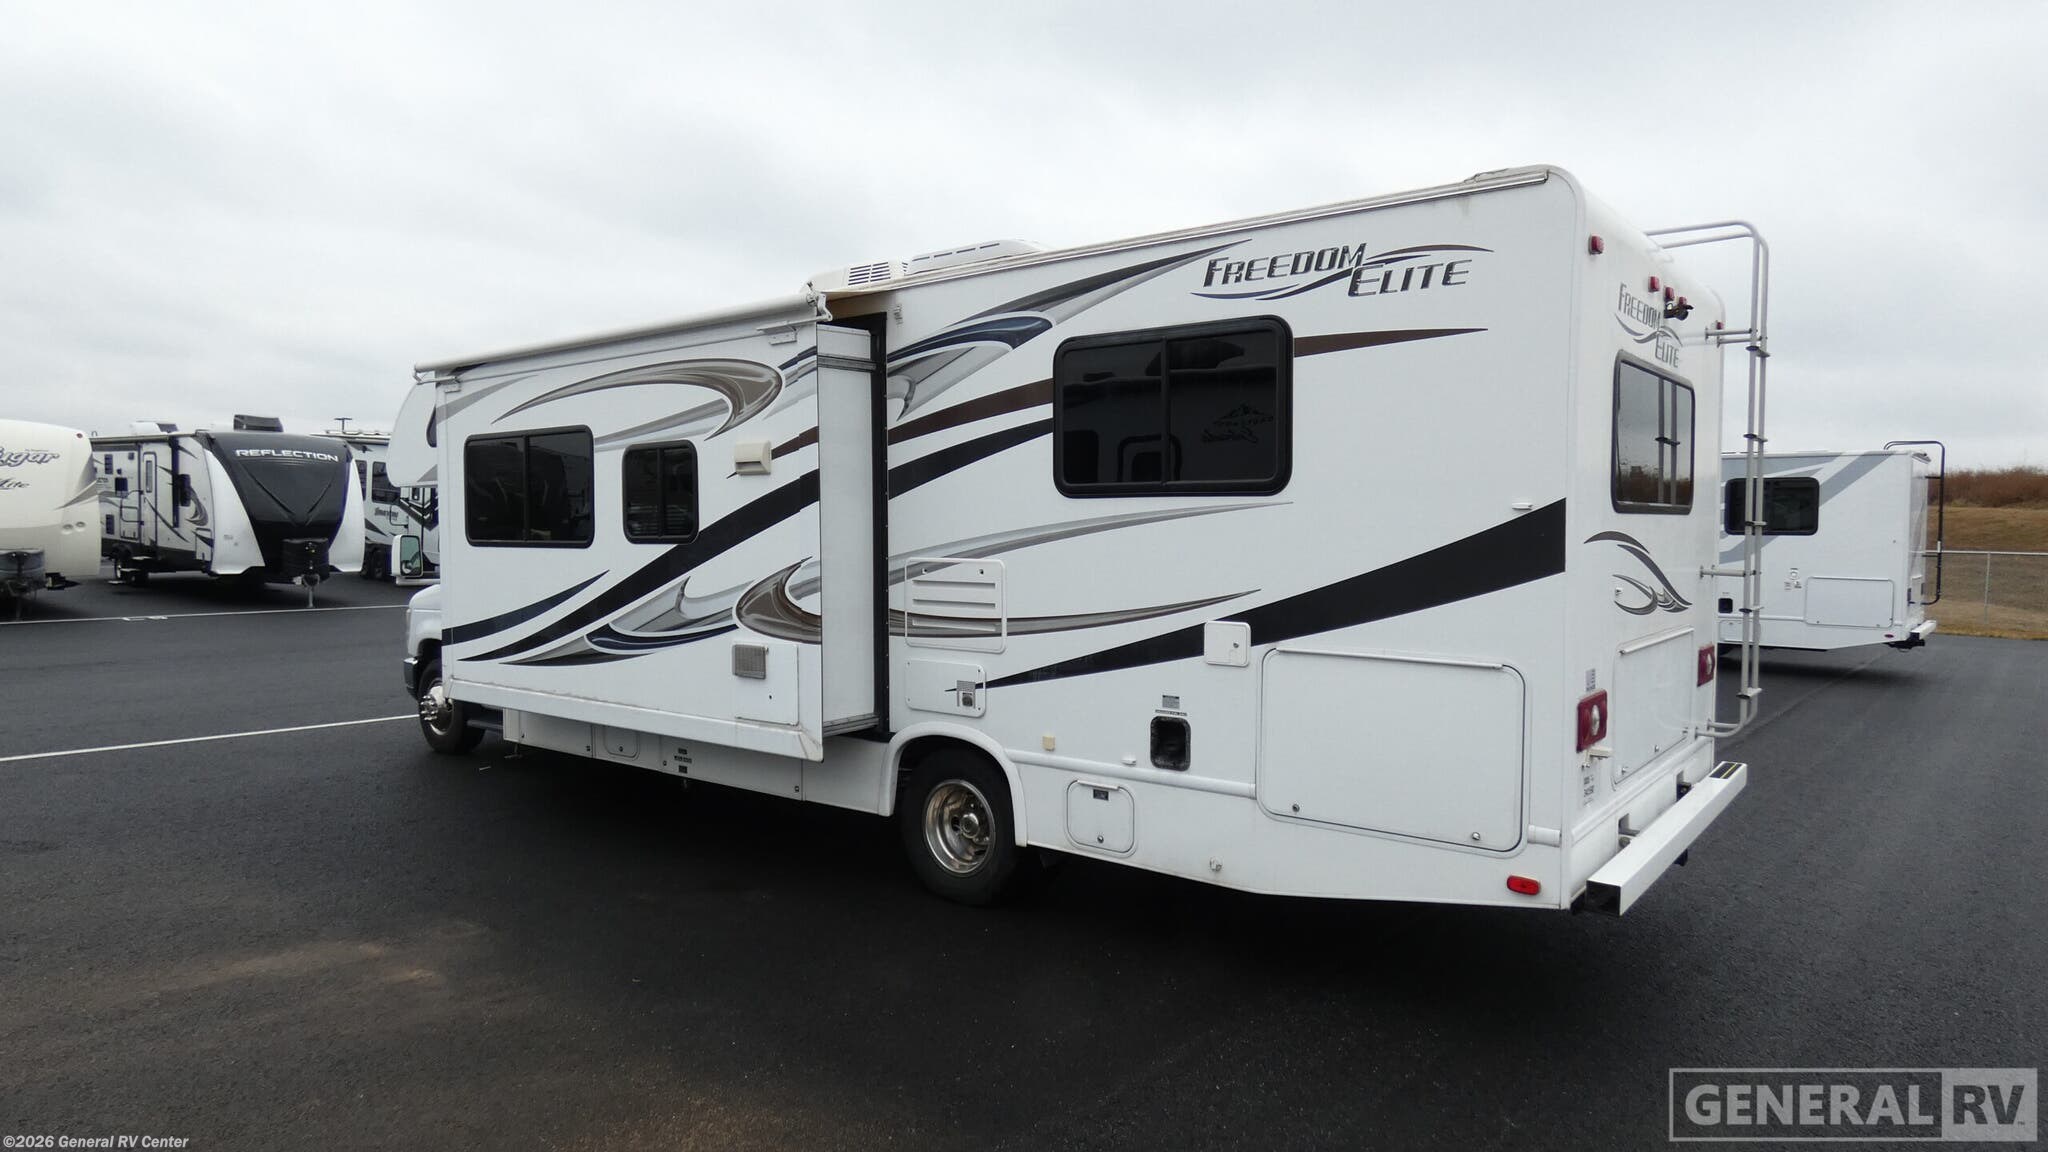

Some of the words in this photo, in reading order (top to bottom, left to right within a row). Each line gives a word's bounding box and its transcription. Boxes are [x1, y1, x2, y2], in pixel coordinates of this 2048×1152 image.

[1203, 243, 1367, 287] FREEDOM
[1348, 259, 1472, 297] ELITE
[1618, 282, 1661, 330] FREEDOM
[1655, 333, 1679, 368] ELITE
[235, 449, 339, 462] REFLECTION
